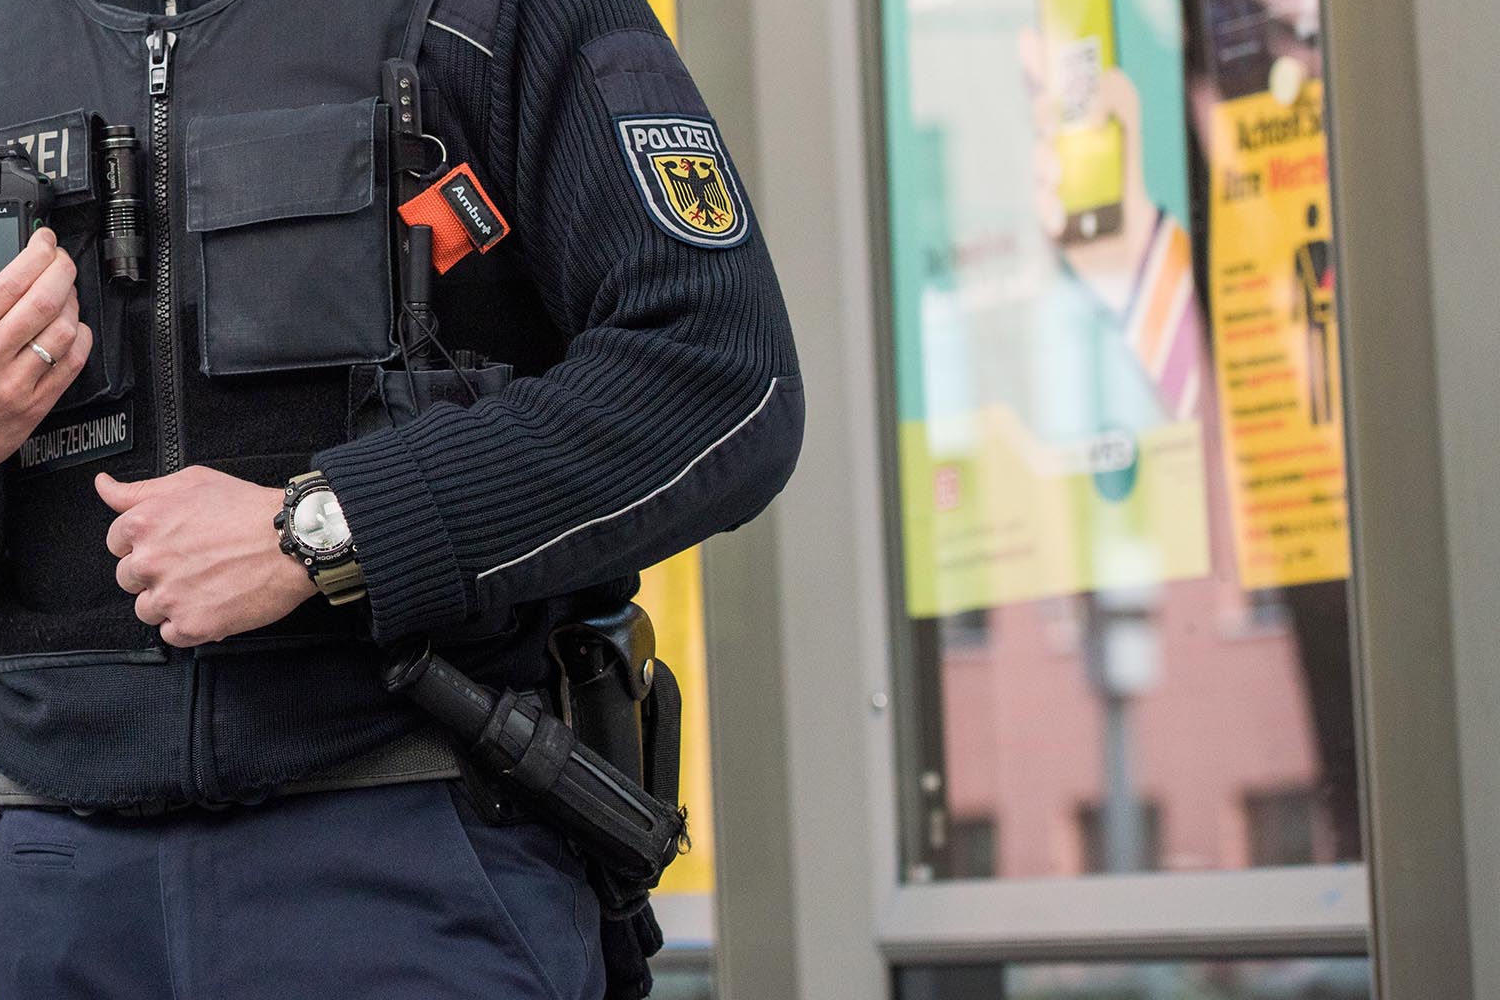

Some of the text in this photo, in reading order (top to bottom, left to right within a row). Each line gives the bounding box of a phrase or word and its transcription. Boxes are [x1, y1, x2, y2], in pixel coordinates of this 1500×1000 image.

[631, 125, 716, 153] POLIZEI
[451, 185, 485, 228] Ambu
[20, 412, 127, 469] VIDEOAUFZEICHNUNG
